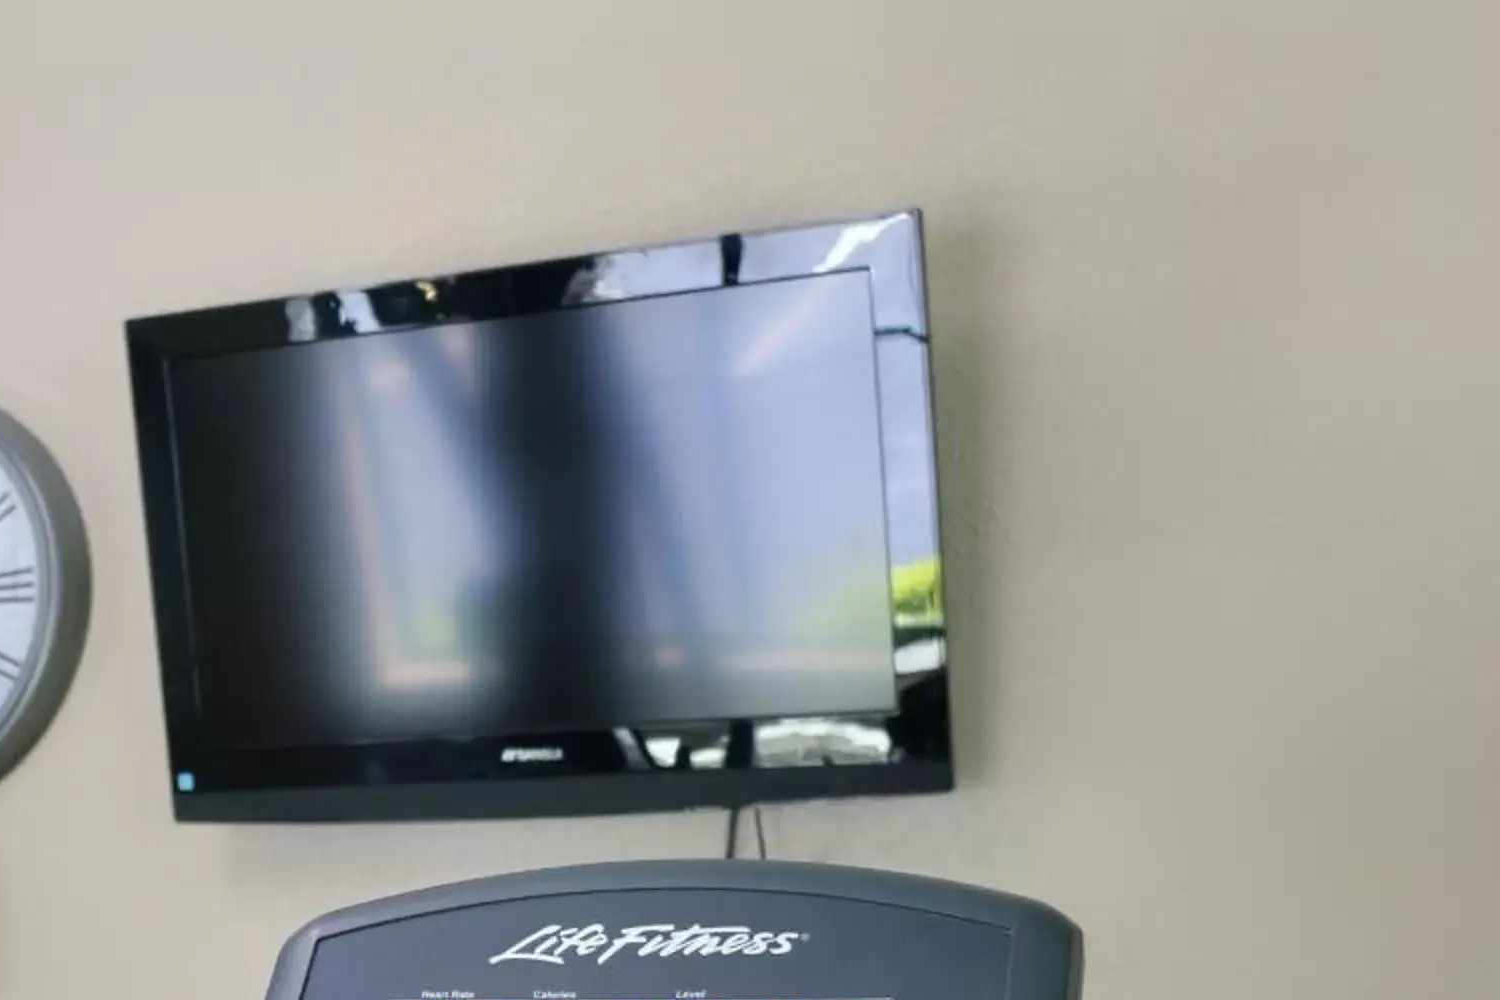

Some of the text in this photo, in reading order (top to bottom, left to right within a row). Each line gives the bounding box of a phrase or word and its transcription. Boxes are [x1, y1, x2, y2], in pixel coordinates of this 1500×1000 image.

[488, 923, 799, 965] Life Fitness
[451, 990, 475, 999] Rate
[533, 990, 577, 999] Calories
[675, 989, 706, 999] Level
